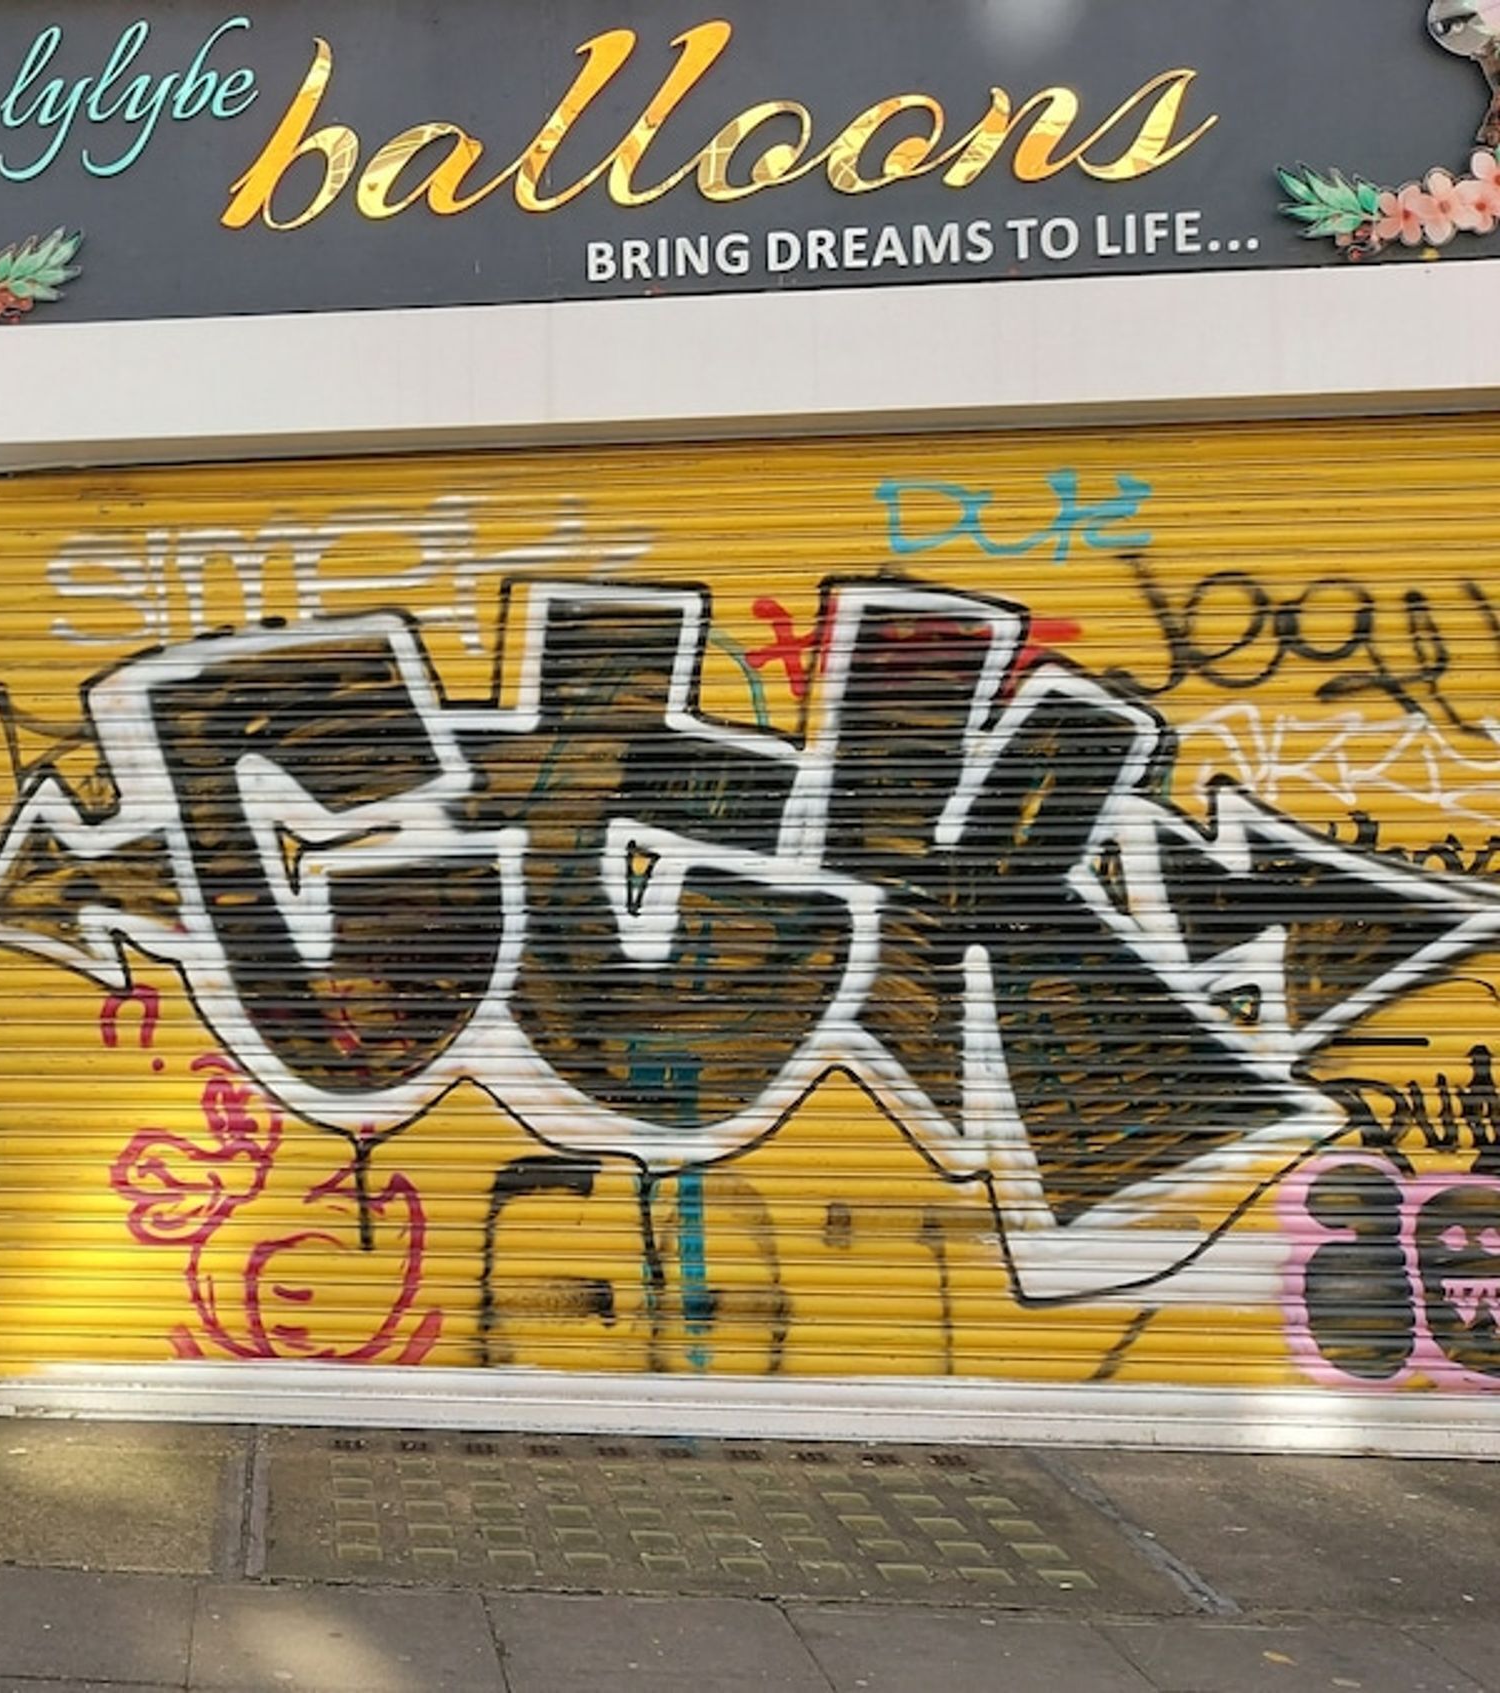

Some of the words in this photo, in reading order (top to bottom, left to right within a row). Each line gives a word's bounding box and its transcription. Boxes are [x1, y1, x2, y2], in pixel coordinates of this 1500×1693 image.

[219, 18, 1219, 230] balloons
[585, 232, 750, 281] BRING
[766, 220, 993, 273] DREAMS
[1006, 216, 1080, 260] TO
[1096, 211, 1260, 257] LIFE...
